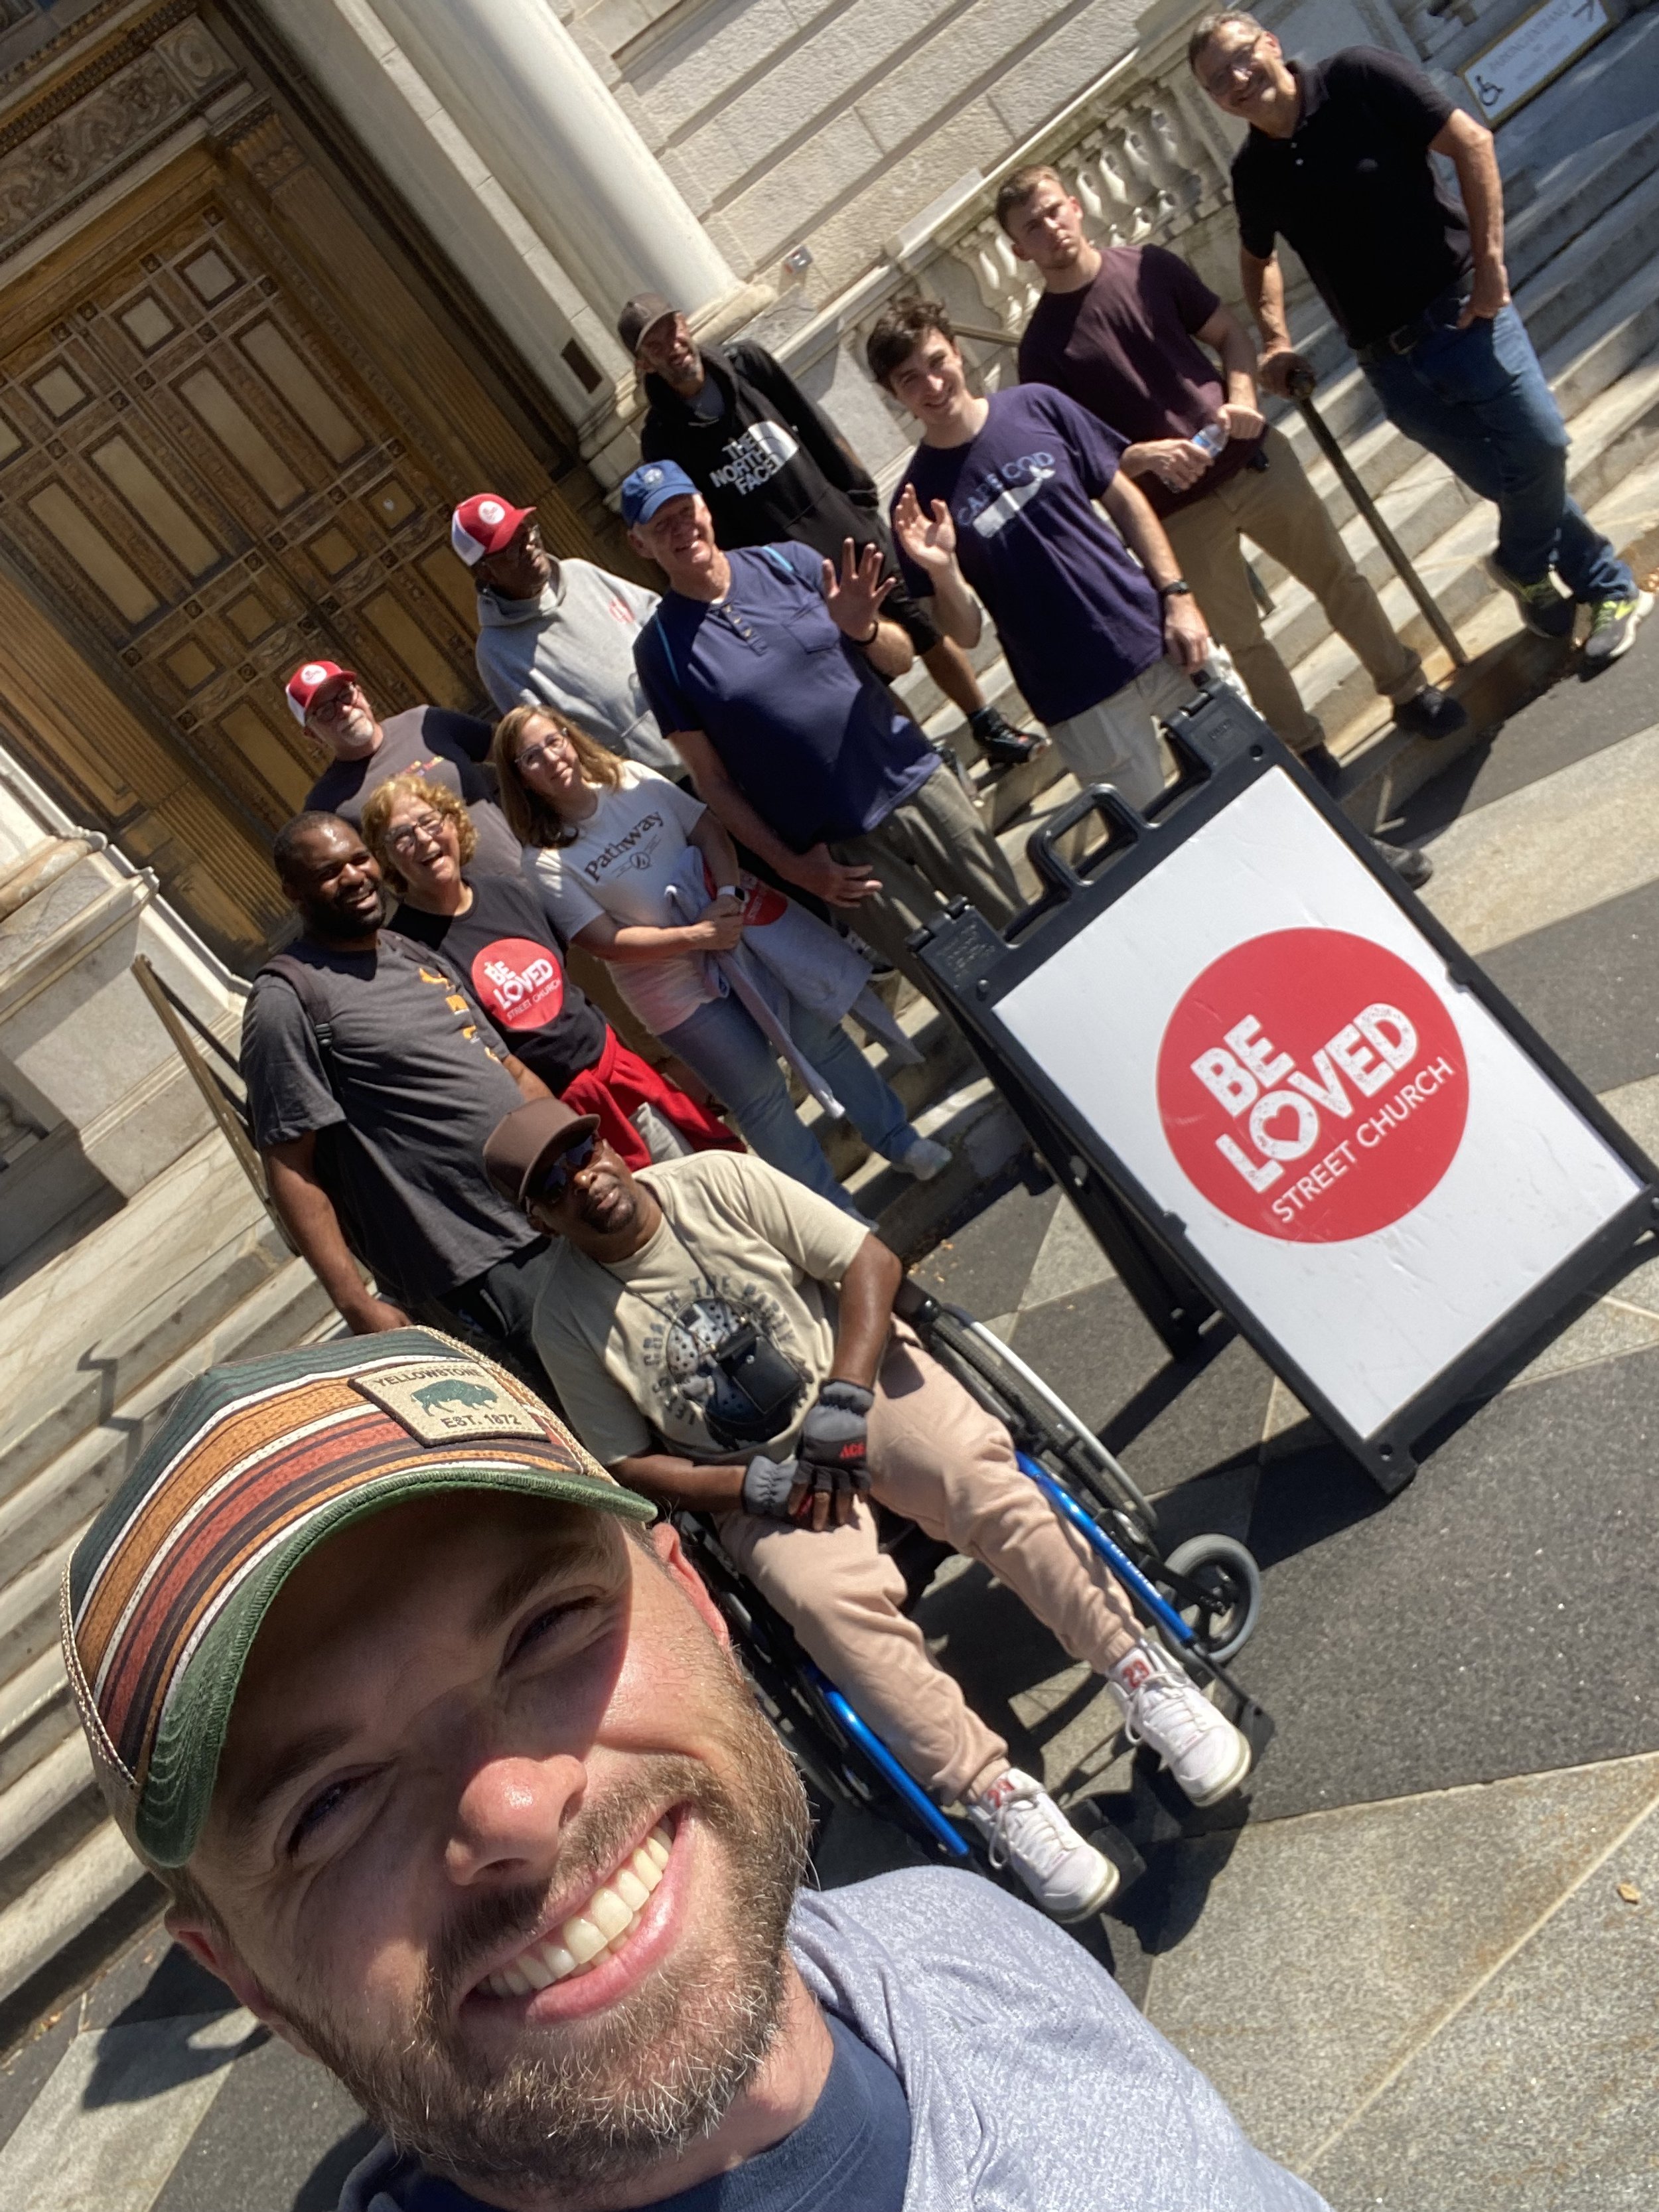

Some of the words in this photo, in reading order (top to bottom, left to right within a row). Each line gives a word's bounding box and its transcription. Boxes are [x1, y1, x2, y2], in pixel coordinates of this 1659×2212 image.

[721, 432, 758, 460] THE
[709, 444, 765, 488] NORTH
[735, 458, 782, 495] FACE
[1001, 451, 1055, 480] COD
[484, 960, 516, 986] BE
[492, 958, 553, 1009] LOVED
[506, 998, 532, 1021] STREET
[532, 978, 561, 1003] CHURCH
[1190, 1013, 1296, 1119] BE
[1214, 1002, 1419, 1194] LOVED
[1271, 1140, 1358, 1223] STREET
[1356, 1056, 1456, 1148] CHURCH
[372, 1366, 483, 1388] YELLOWSTONE
[440, 1414, 482, 1429] EST.
[484, 1413, 522, 1426] 1872
[1121, 1659, 1150, 1689] 23
